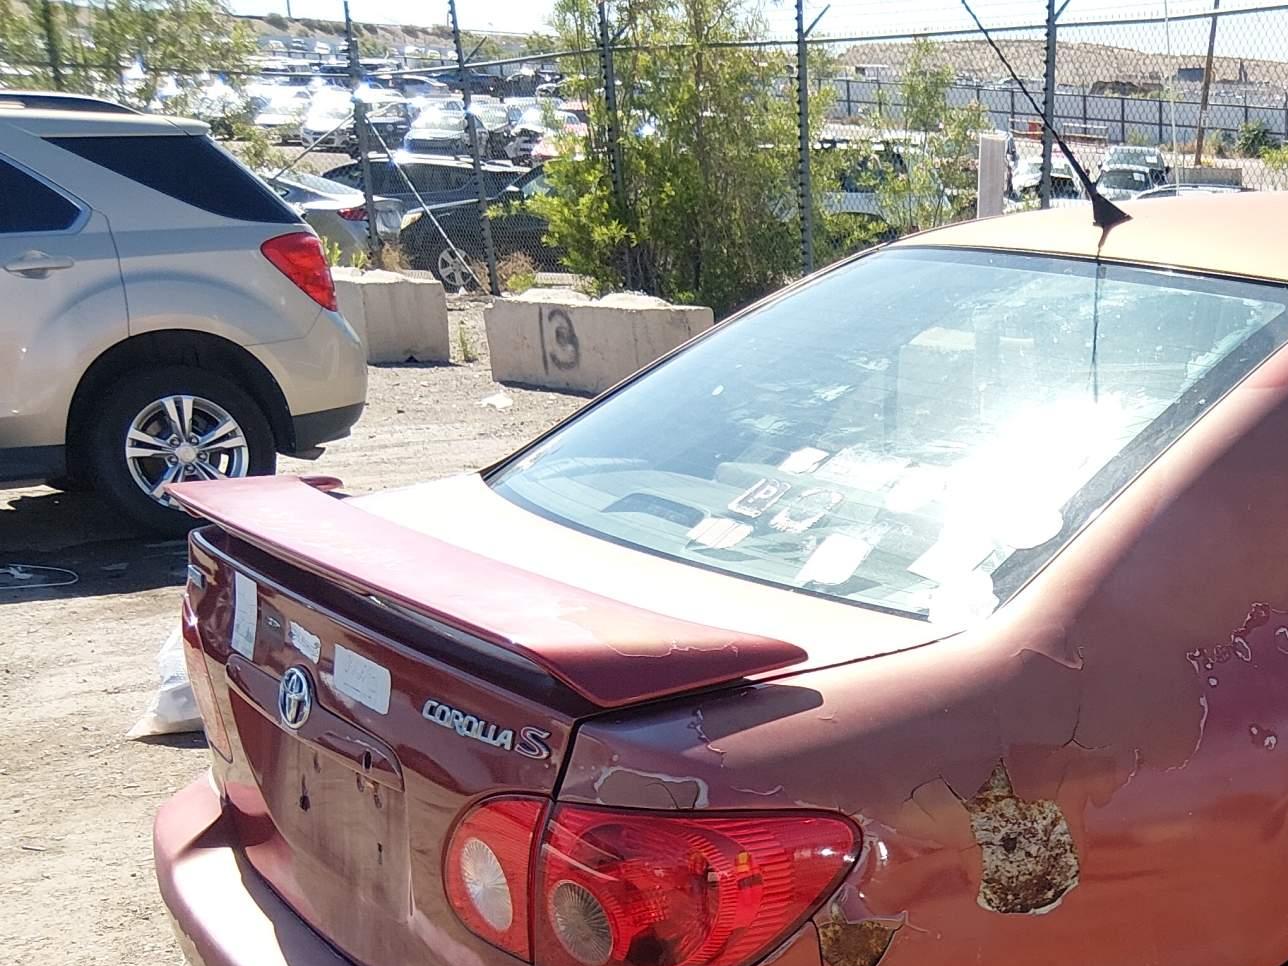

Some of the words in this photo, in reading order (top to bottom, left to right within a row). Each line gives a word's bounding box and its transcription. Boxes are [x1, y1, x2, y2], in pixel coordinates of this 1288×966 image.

[538, 306, 580, 375] 13
[422, 700, 513, 750] COROLLA
[515, 726, 551, 760] S
